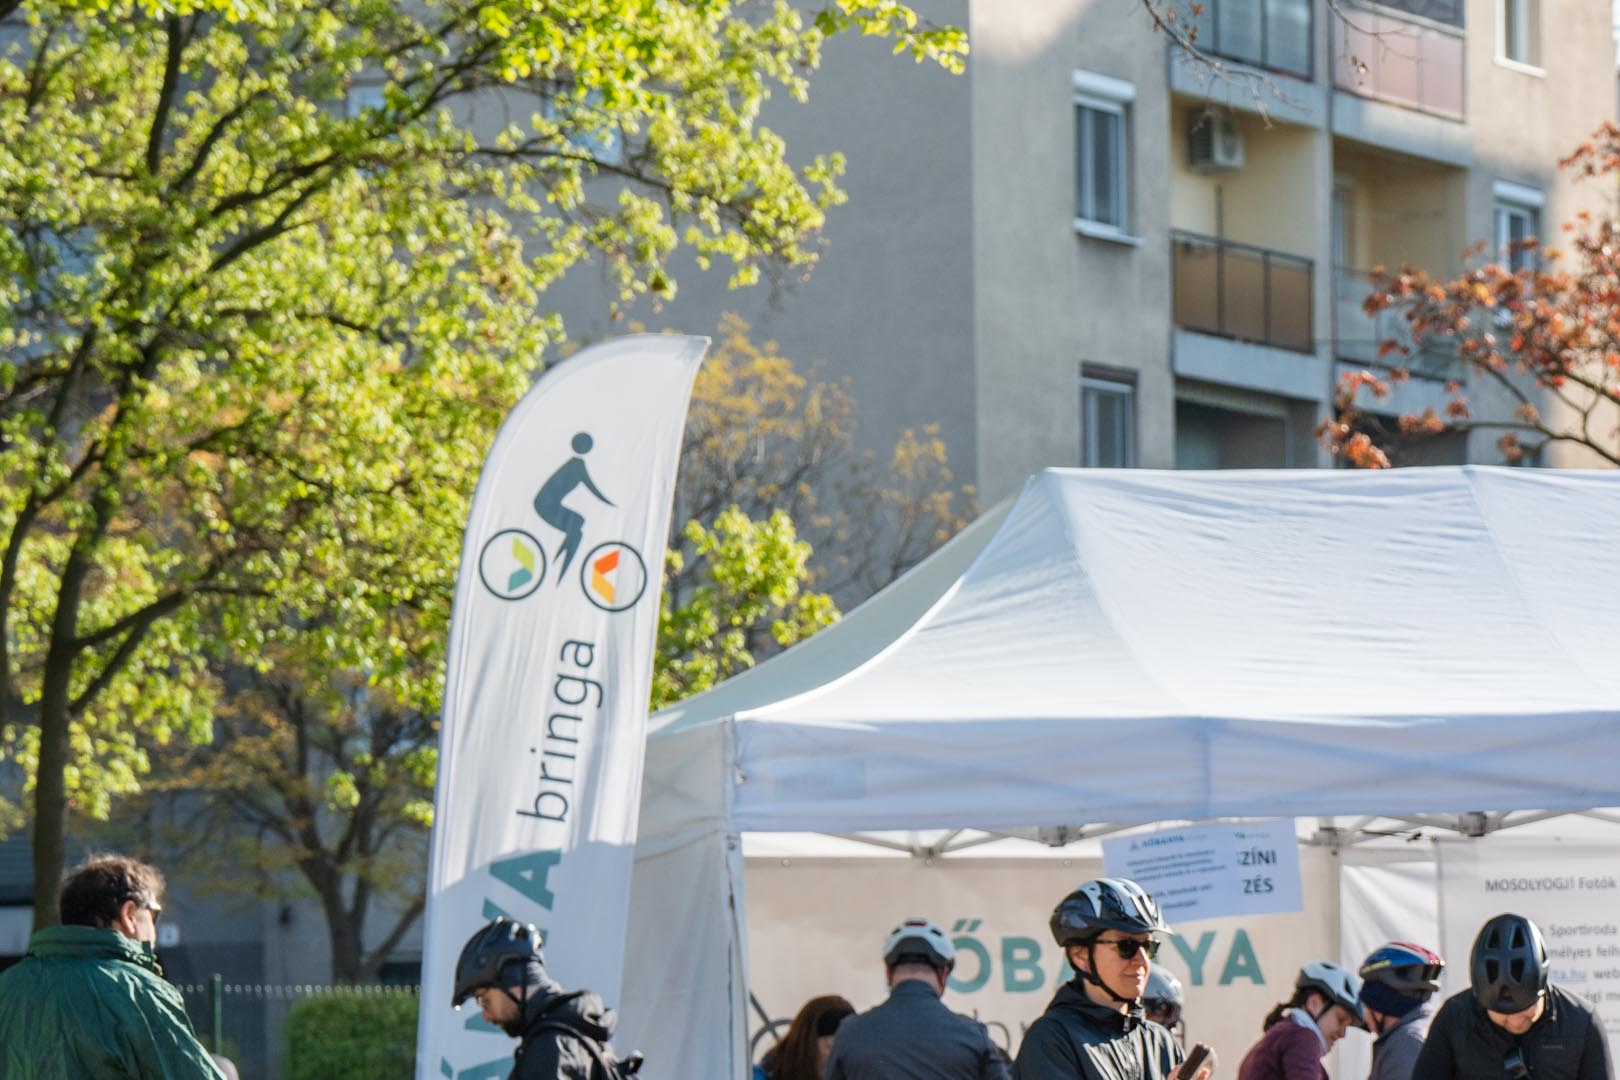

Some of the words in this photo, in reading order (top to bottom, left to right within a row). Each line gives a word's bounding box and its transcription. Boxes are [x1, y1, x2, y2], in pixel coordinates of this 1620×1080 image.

[516, 639, 603, 823] bringa
[1237, 847, 1278, 867] ZÍNI
[946, 918, 1267, 994] ŐBYA
